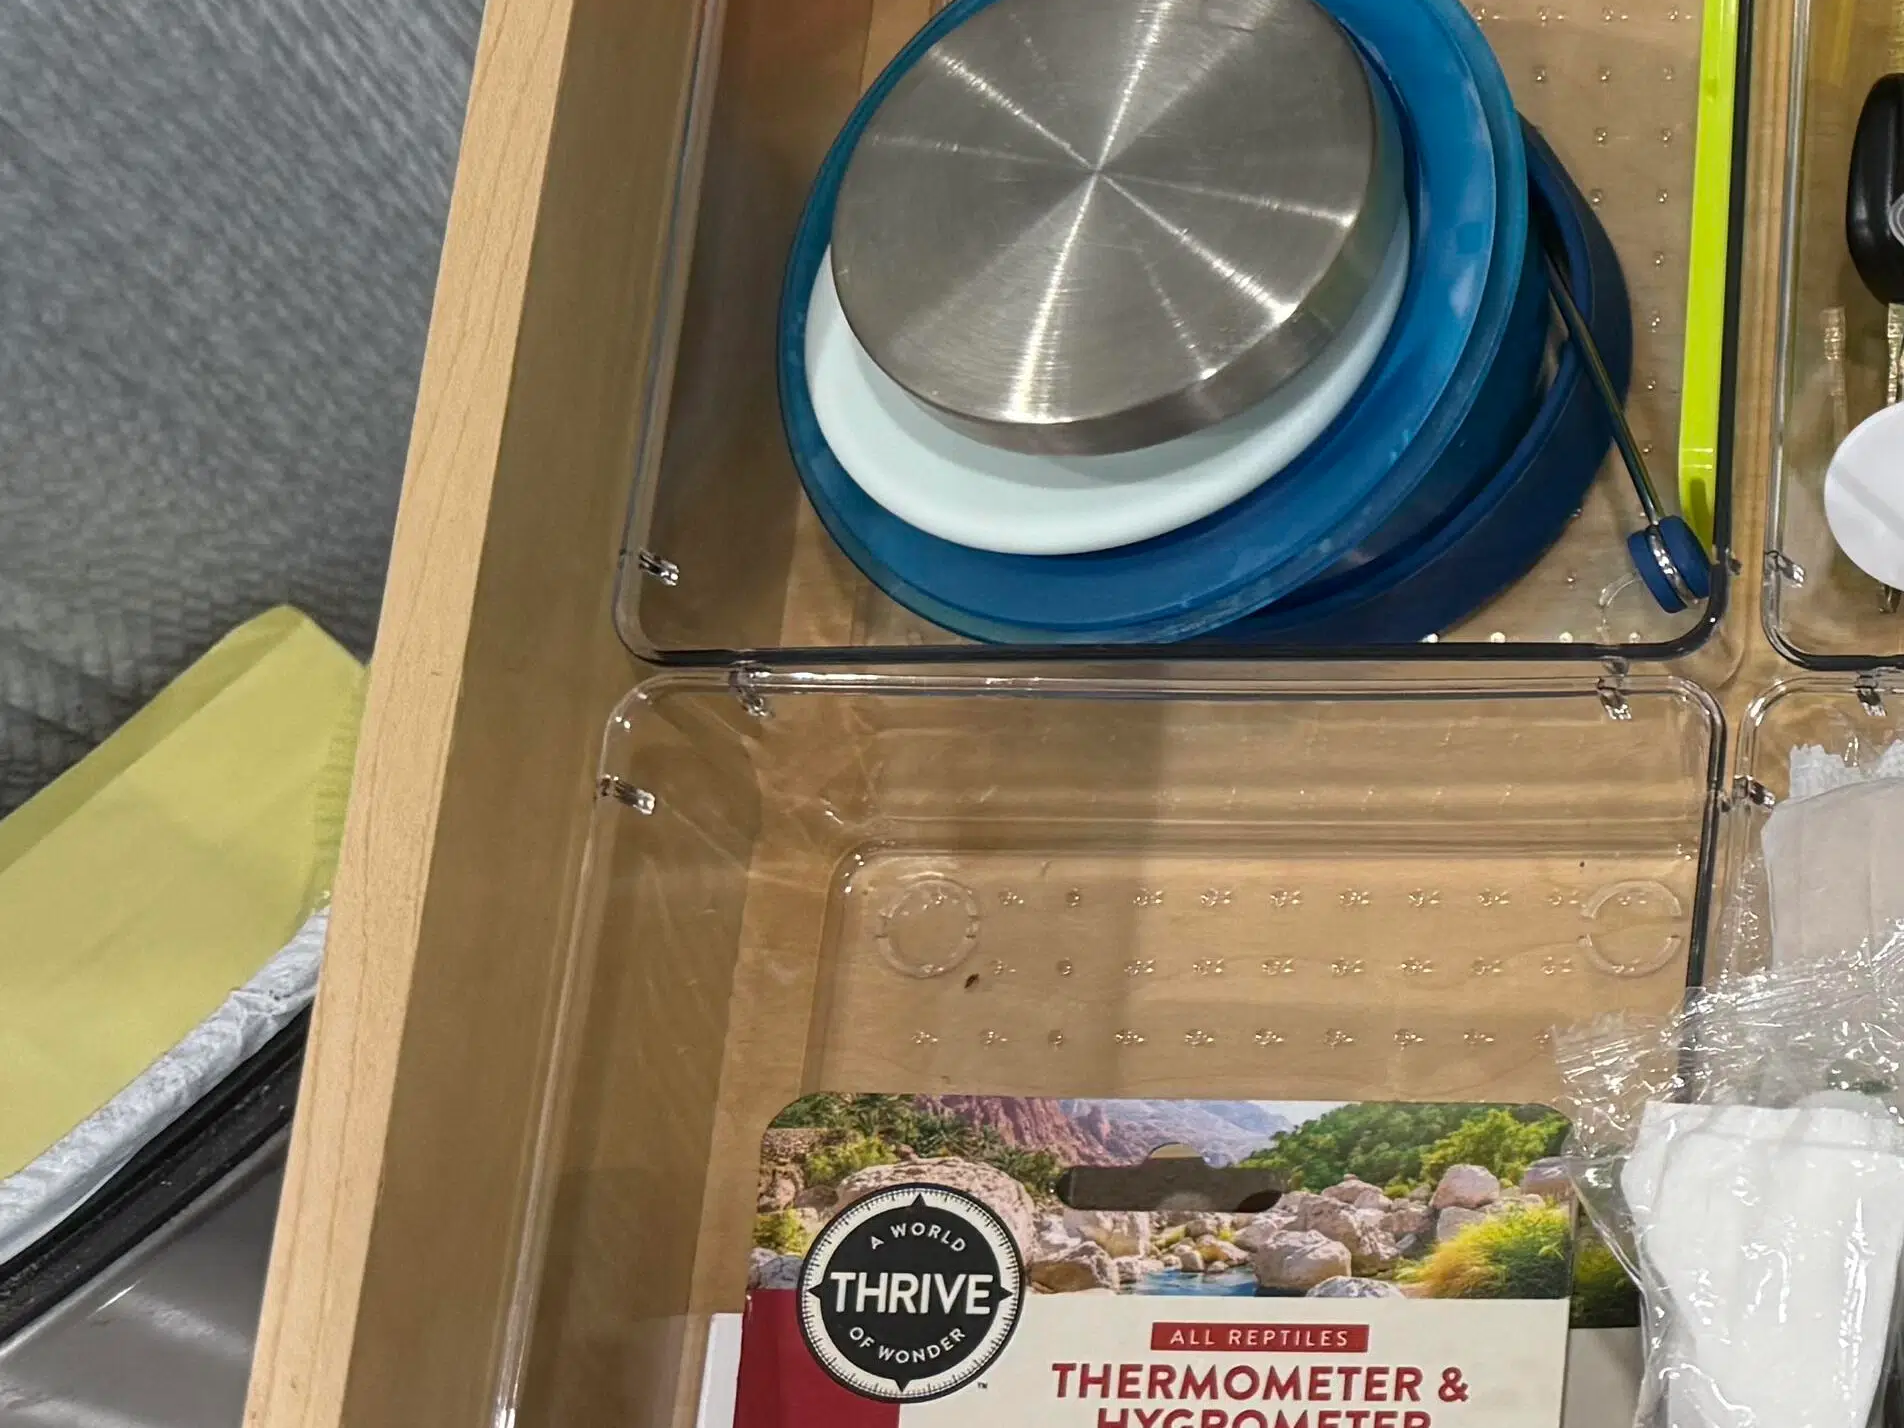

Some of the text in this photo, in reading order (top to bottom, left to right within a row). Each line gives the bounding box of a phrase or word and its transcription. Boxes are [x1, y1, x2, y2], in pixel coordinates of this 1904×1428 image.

[869, 1222, 967, 1252] A WORLD
[830, 1271, 995, 1315] THRIVE
[849, 1326, 967, 1365] OF WONDER
[1170, 1329, 1350, 1347] ALL REPTILES
[1052, 1363, 1469, 1403] THERMOMETER &
